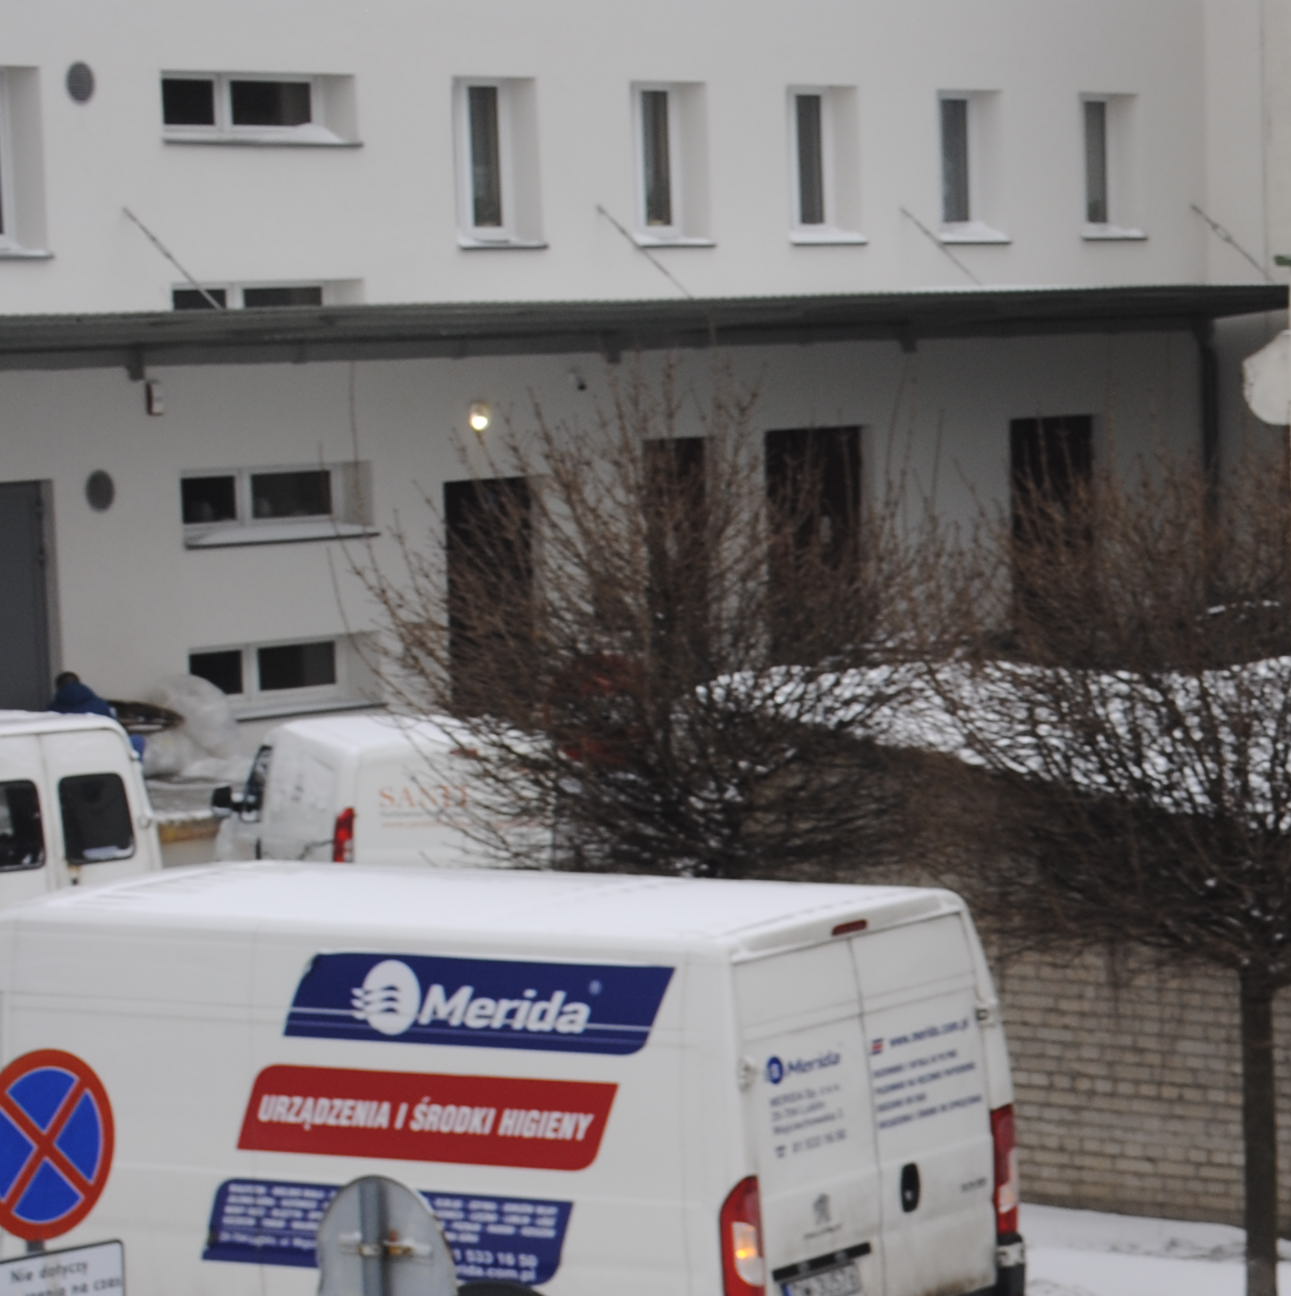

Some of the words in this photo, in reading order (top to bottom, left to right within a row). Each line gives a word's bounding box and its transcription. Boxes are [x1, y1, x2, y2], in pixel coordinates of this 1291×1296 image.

[419, 984, 592, 1035] Merida
[257, 1093, 390, 1132] URZĄDZENIA
[395, 1102, 407, 1130] I
[410, 1097, 497, 1135] ŚRODKI
[497, 1109, 594, 1141] HIGIENY
